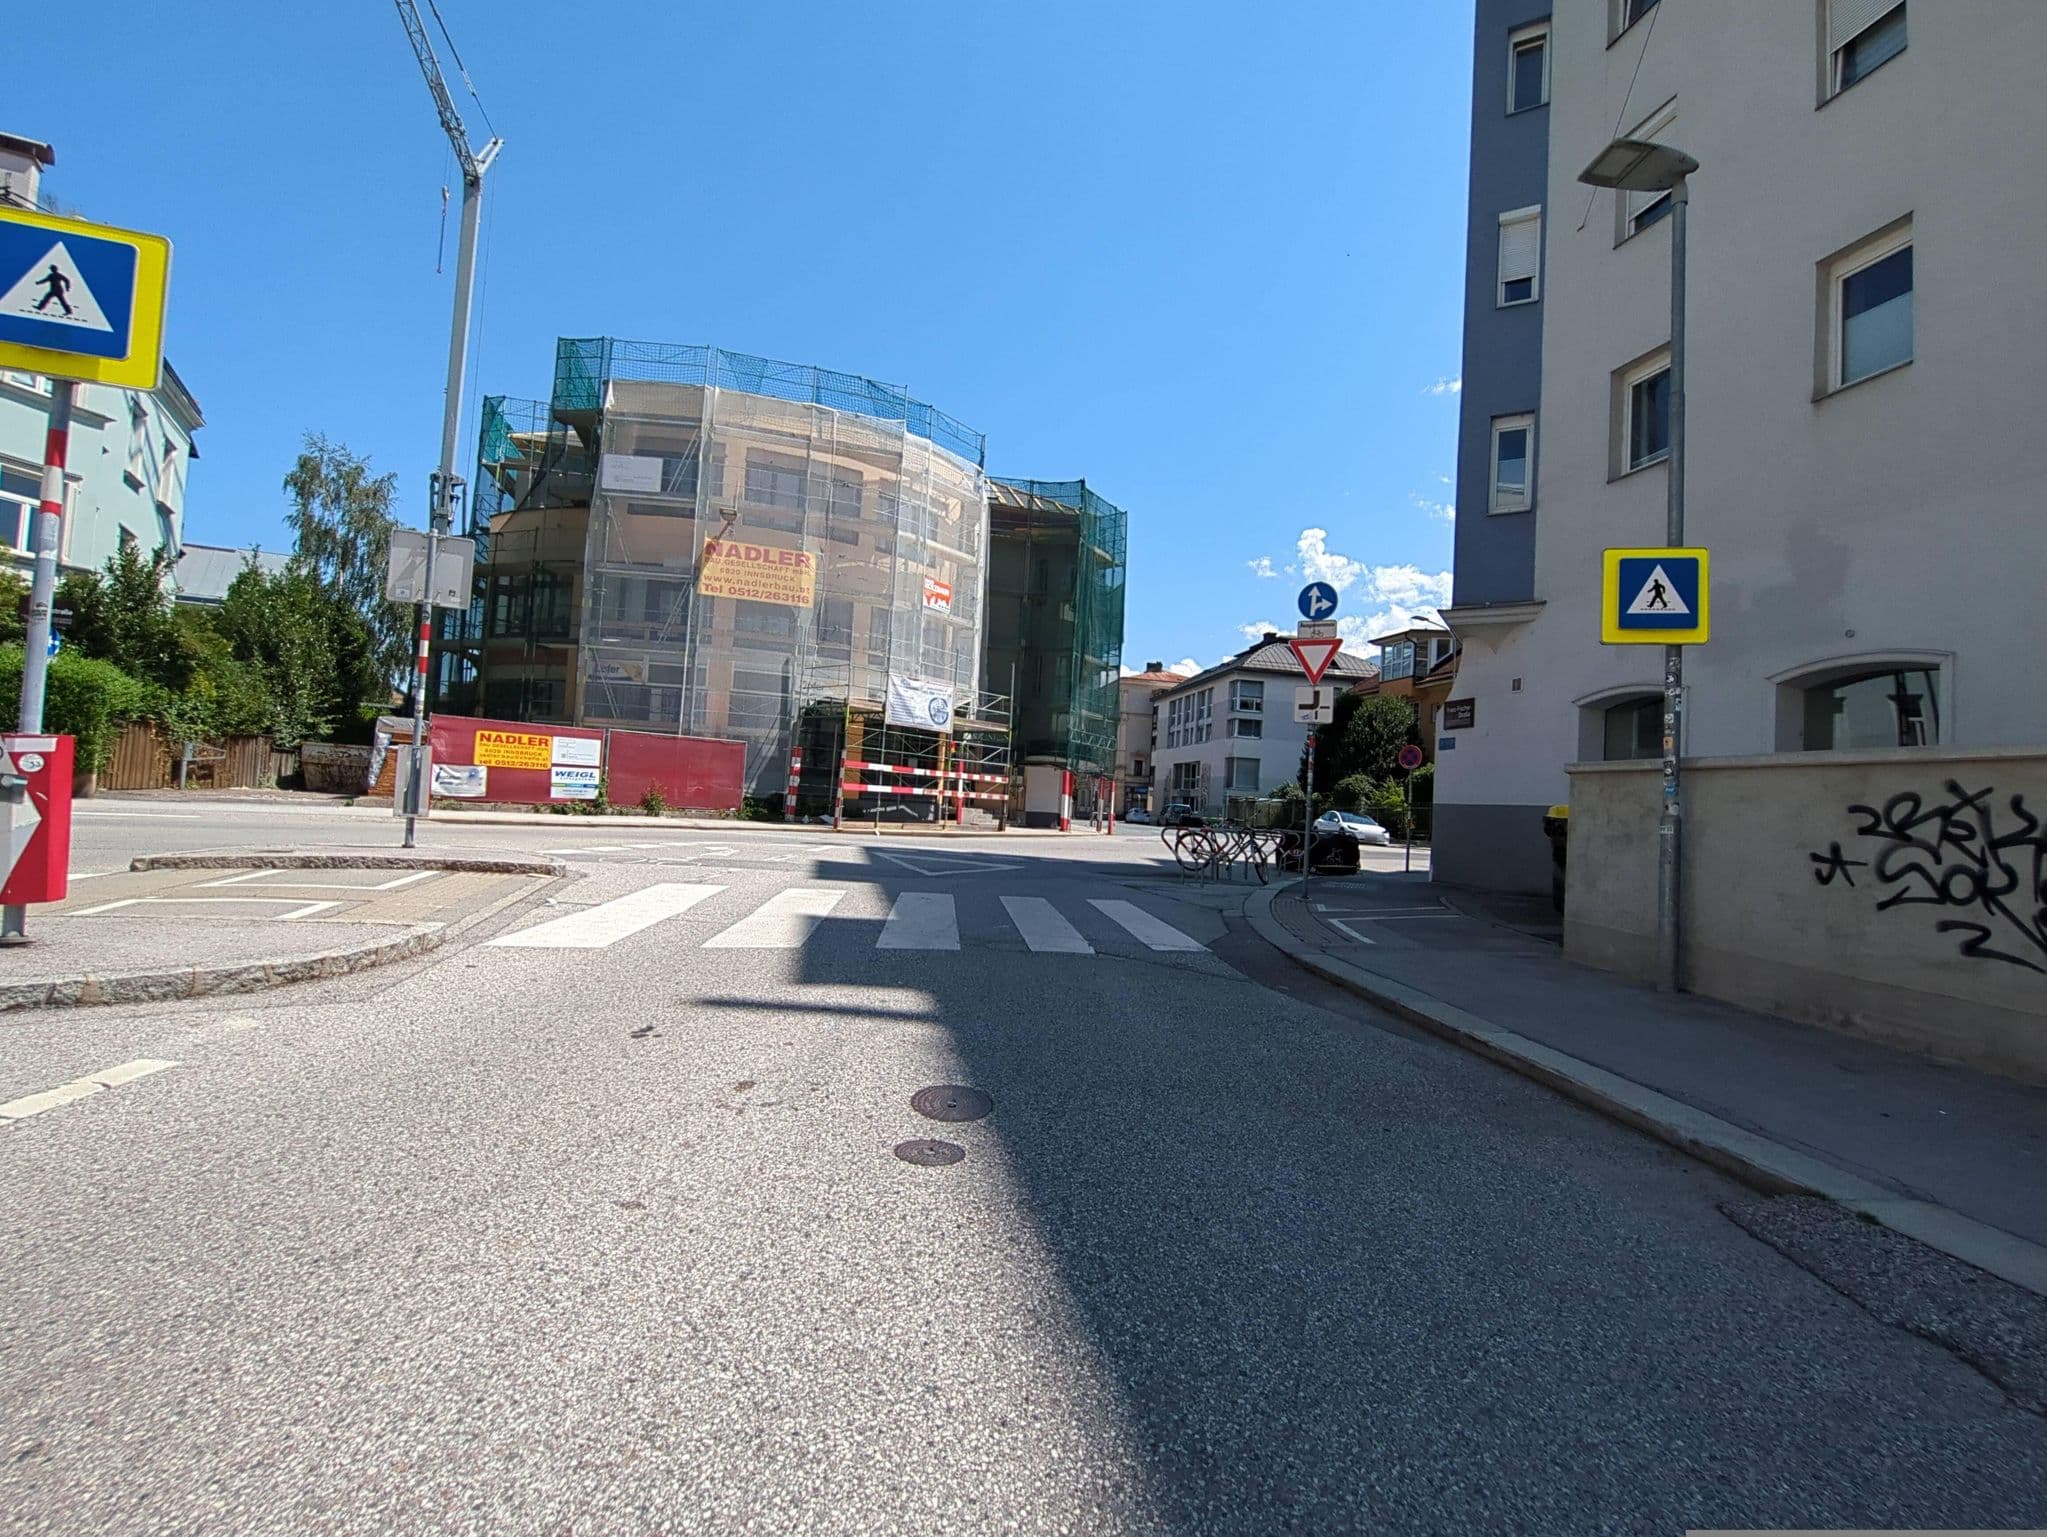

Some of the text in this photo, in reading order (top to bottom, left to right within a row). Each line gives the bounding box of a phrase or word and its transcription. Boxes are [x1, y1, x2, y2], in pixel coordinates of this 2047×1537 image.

[705, 541, 811, 568] NADLER
[704, 556, 720, 565] BAU
[724, 559, 789, 574] GESELLSCHAFT
[720, 567, 796, 582] 6020 INNSBRUCK
[702, 583, 810, 604] Tel 0512/263116
[703, 575, 810, 594] www.nadlerbau.at
[479, 732, 549, 747] NADLER
[554, 770, 597, 779] WEIGL
